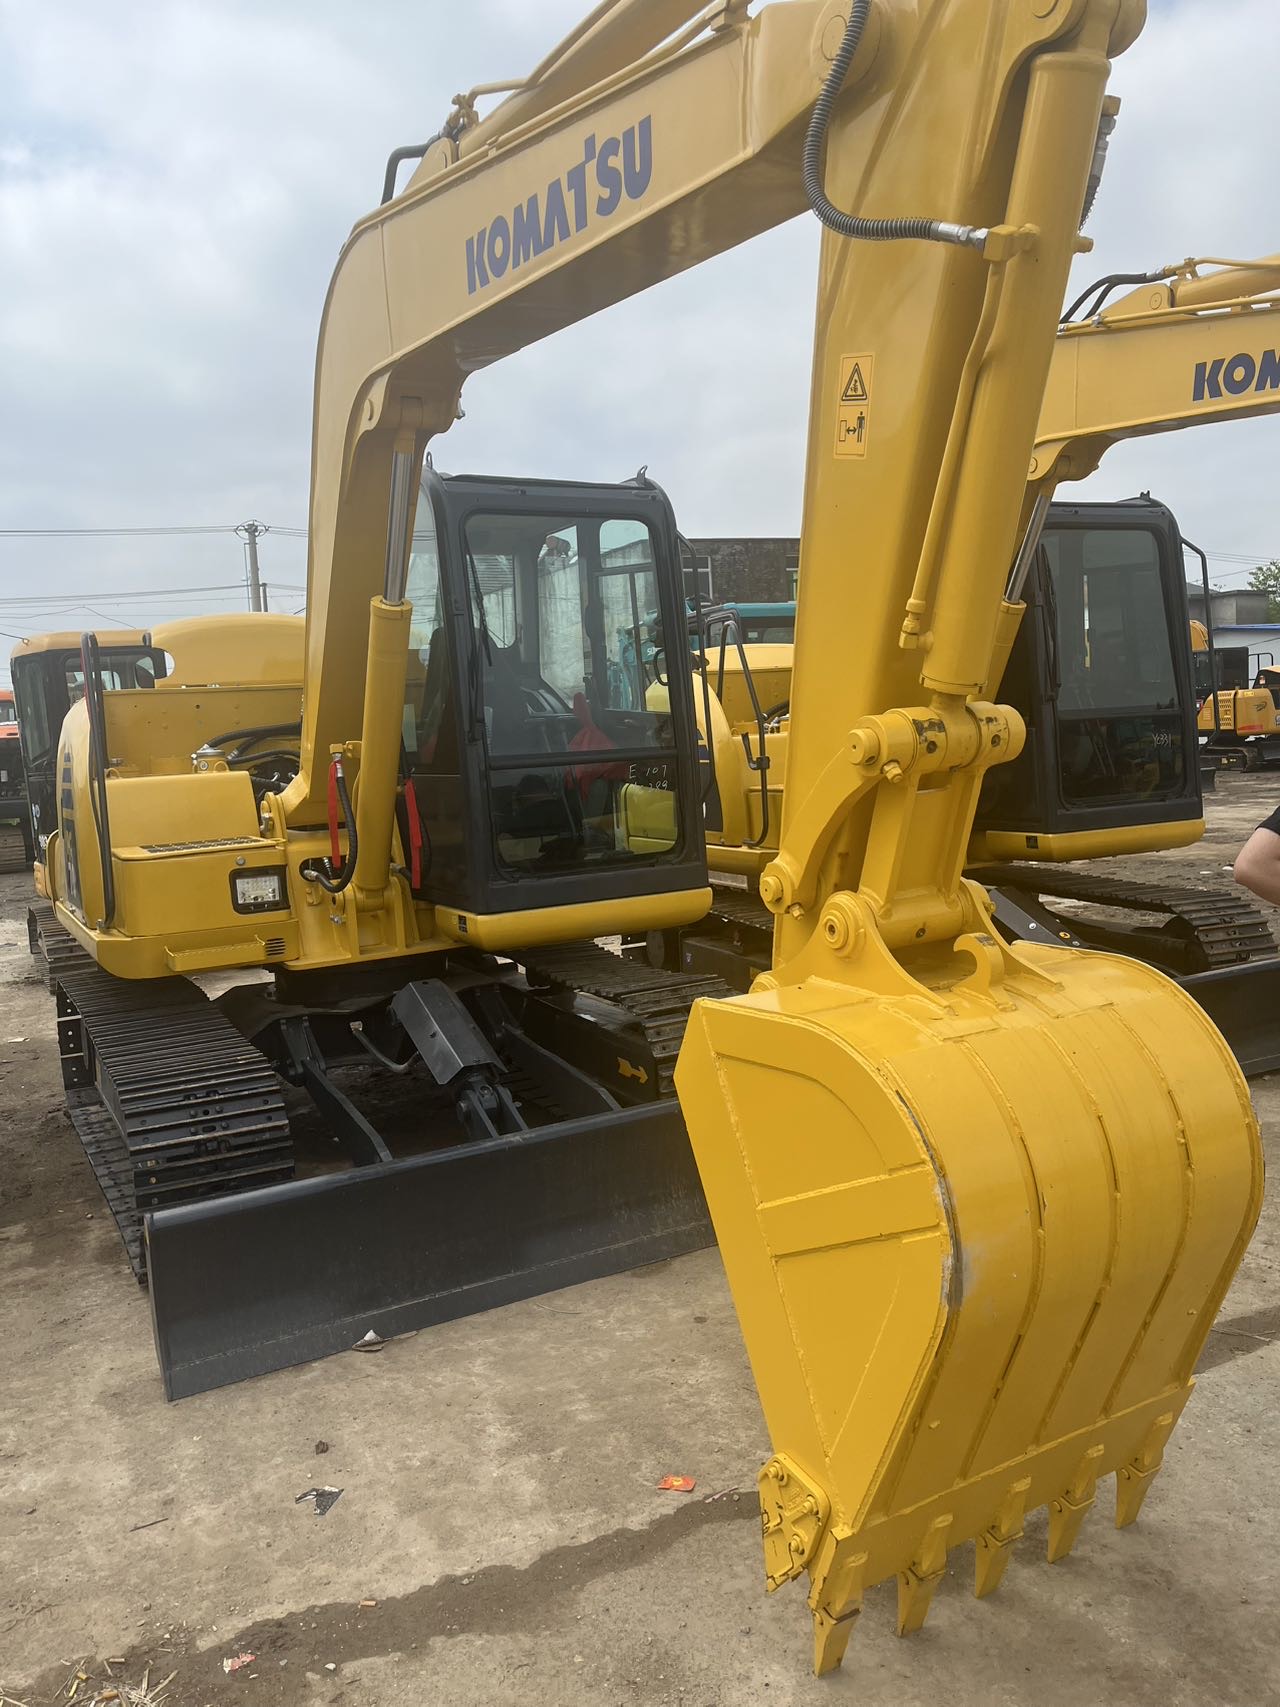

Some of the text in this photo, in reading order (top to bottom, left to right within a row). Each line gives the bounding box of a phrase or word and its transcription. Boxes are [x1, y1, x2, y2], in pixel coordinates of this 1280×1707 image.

[465, 114, 652, 296] KOMATSU
[1192, 349, 1280, 402] KOM
[629, 763, 637, 779] E
